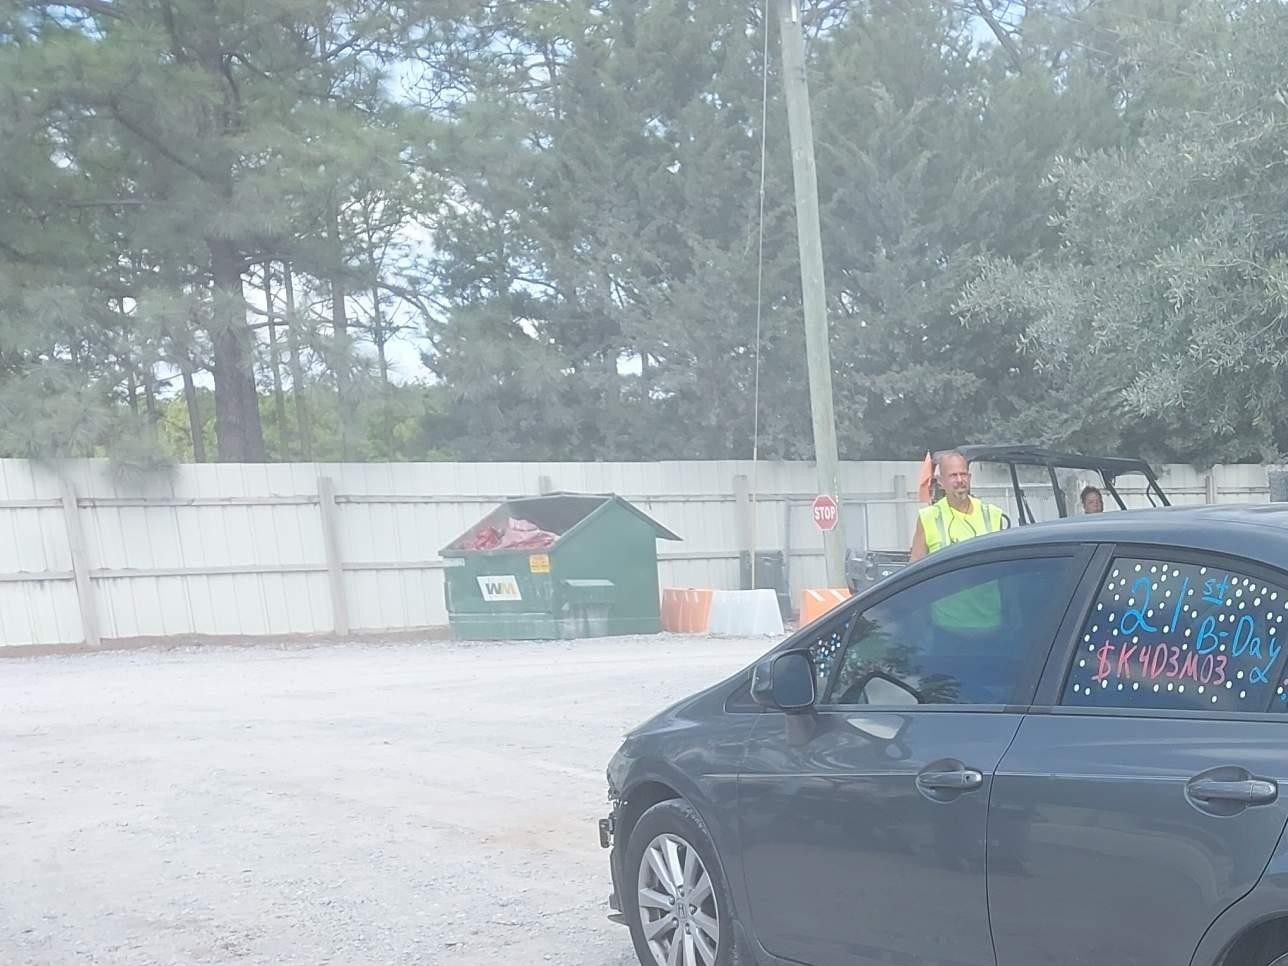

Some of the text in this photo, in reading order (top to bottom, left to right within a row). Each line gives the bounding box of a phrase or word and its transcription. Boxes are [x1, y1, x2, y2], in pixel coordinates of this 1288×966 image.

[814, 506, 836, 520] STOP
[484, 582, 517, 595] WM
[1196, 614, 1281, 684] B-Day
